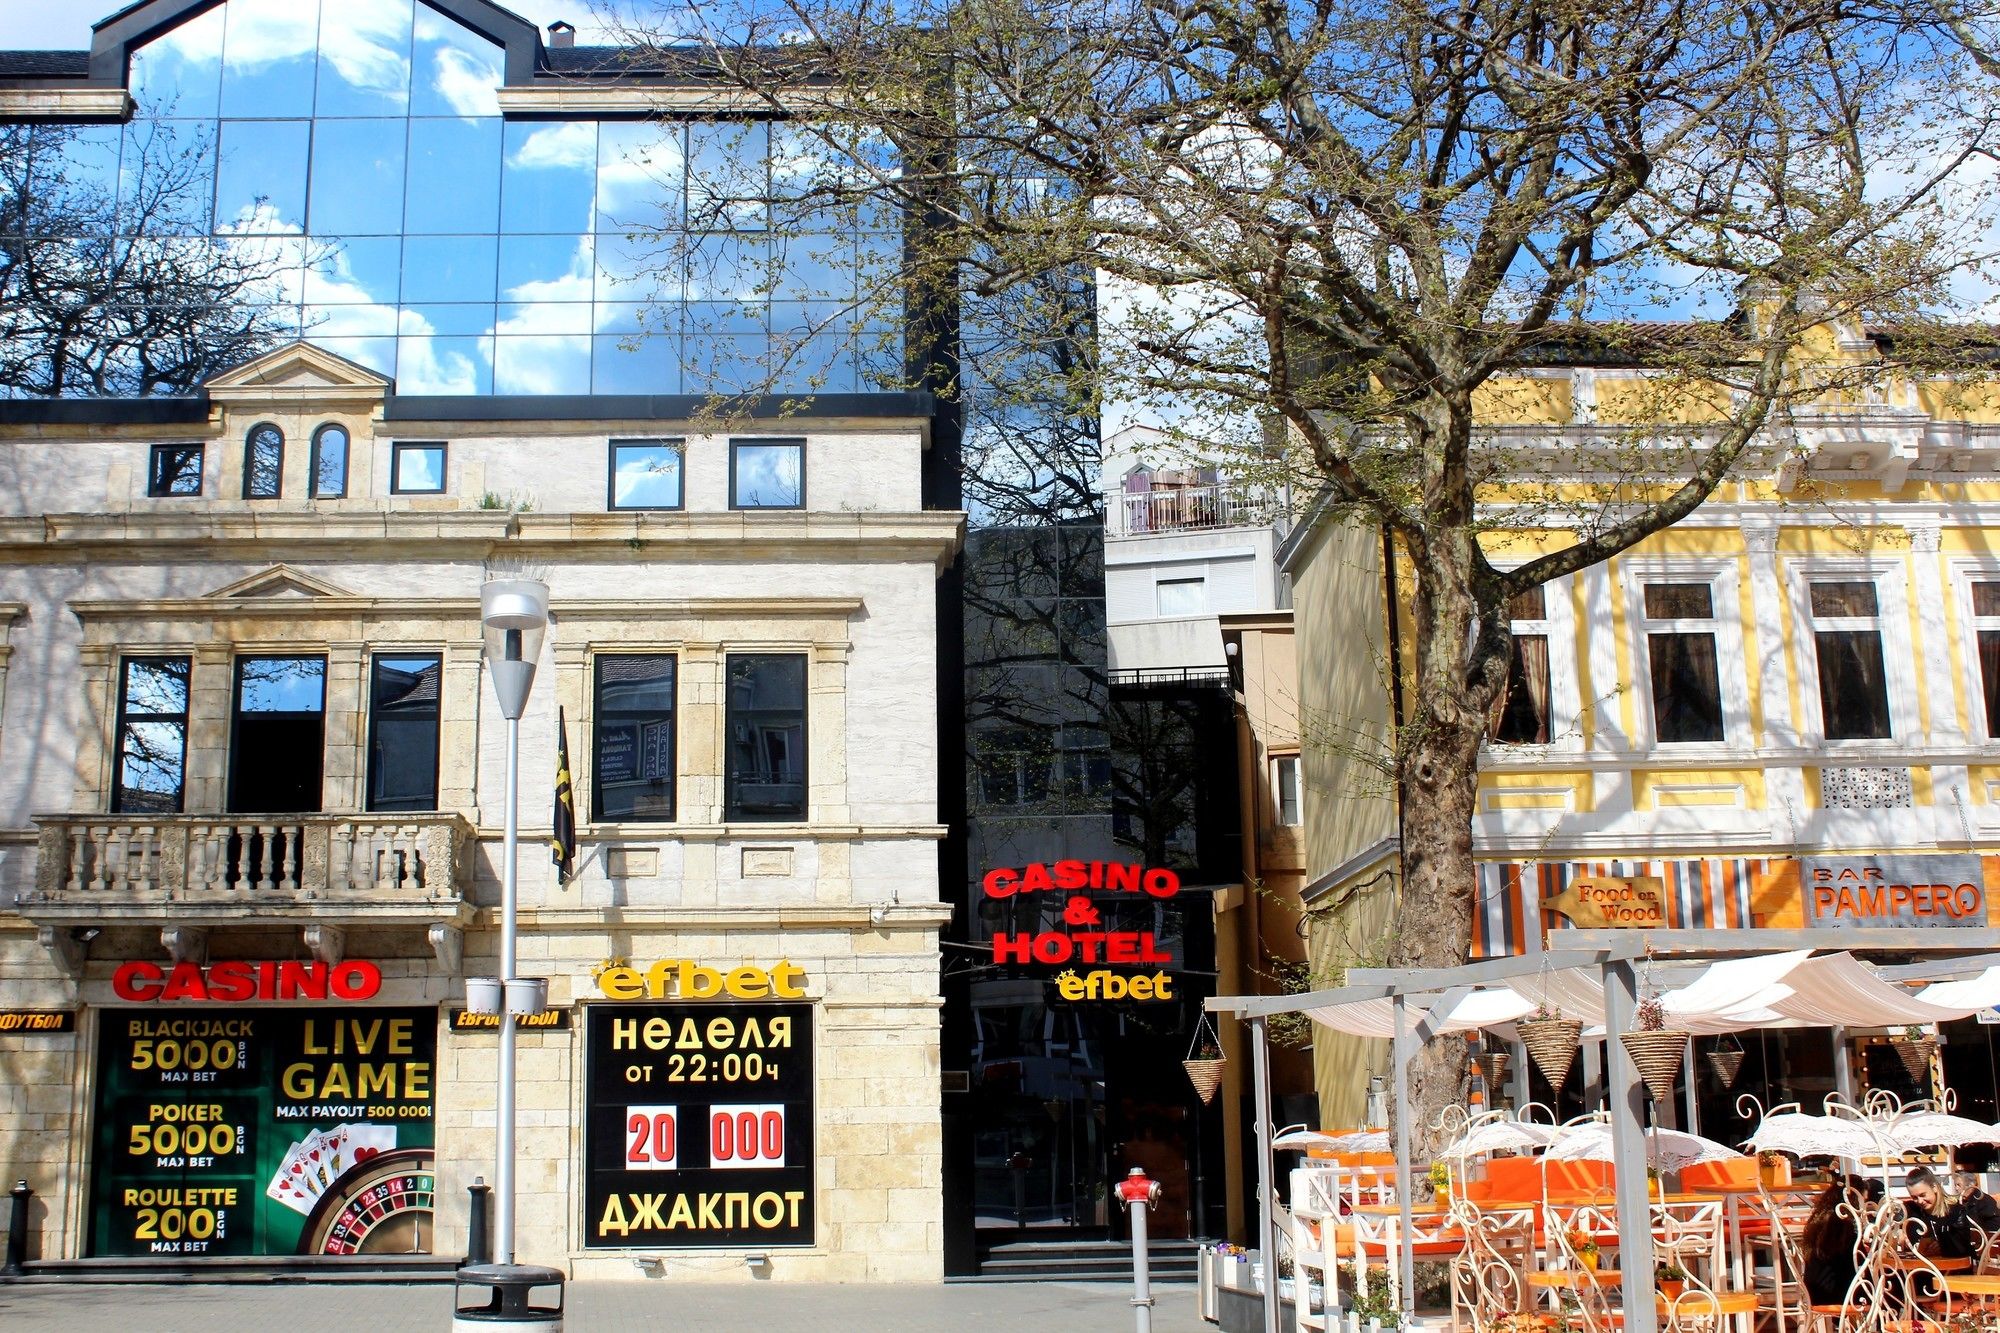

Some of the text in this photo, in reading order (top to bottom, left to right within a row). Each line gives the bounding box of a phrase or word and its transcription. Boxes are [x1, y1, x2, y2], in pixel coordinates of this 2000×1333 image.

[983, 859, 1180, 898] CASINO
[1813, 867, 1884, 881] BAR
[1578, 883, 1656, 902] Food on
[1814, 883, 1981, 918] PAMPERO
[1063, 896, 1100, 925] &
[1600, 902, 1662, 921] Wood
[993, 931, 1172, 964] HOTEL
[113, 960, 382, 1000] CASINO
[599, 959, 805, 999] efbet
[1058, 970, 1172, 1000] efbet
[0, 1013, 64, 1029] ФУТБОЛ
[129, 1020, 253, 1037] BLACKJACK
[304, 1019, 413, 1055] LIVE
[131, 1039, 236, 1070] 5000
[161, 1072, 217, 1082] MAX BET
[282, 1062, 430, 1099] GAME
[625, 1065, 653, 1082] от
[150, 1104, 223, 1122] POKER
[276, 1106, 309, 1118] MAX
[311, 1106, 365, 1118] PAYOUT
[367, 1106, 396, 1118] 500
[128, 1124, 236, 1156] 5000
[628, 1110, 783, 1163] 20 000
[157, 1157, 214, 1168] MAX BET
[124, 1188, 238, 1206] ROULETTE
[333, 1224, 346, 1238] 33
[353, 1202, 362, 1213] 4
[362, 1192, 376, 1206] 23
[375, 1185, 389, 1198] 35
[390, 1181, 403, 1193] 14
[406, 1178, 414, 1189] 2
[421, 1178, 428, 1189] 0
[135, 1208, 214, 1239] 200
[599, 1191, 805, 1237] ДЖАКПОТ
[151, 1242, 209, 1253] MAX BET
